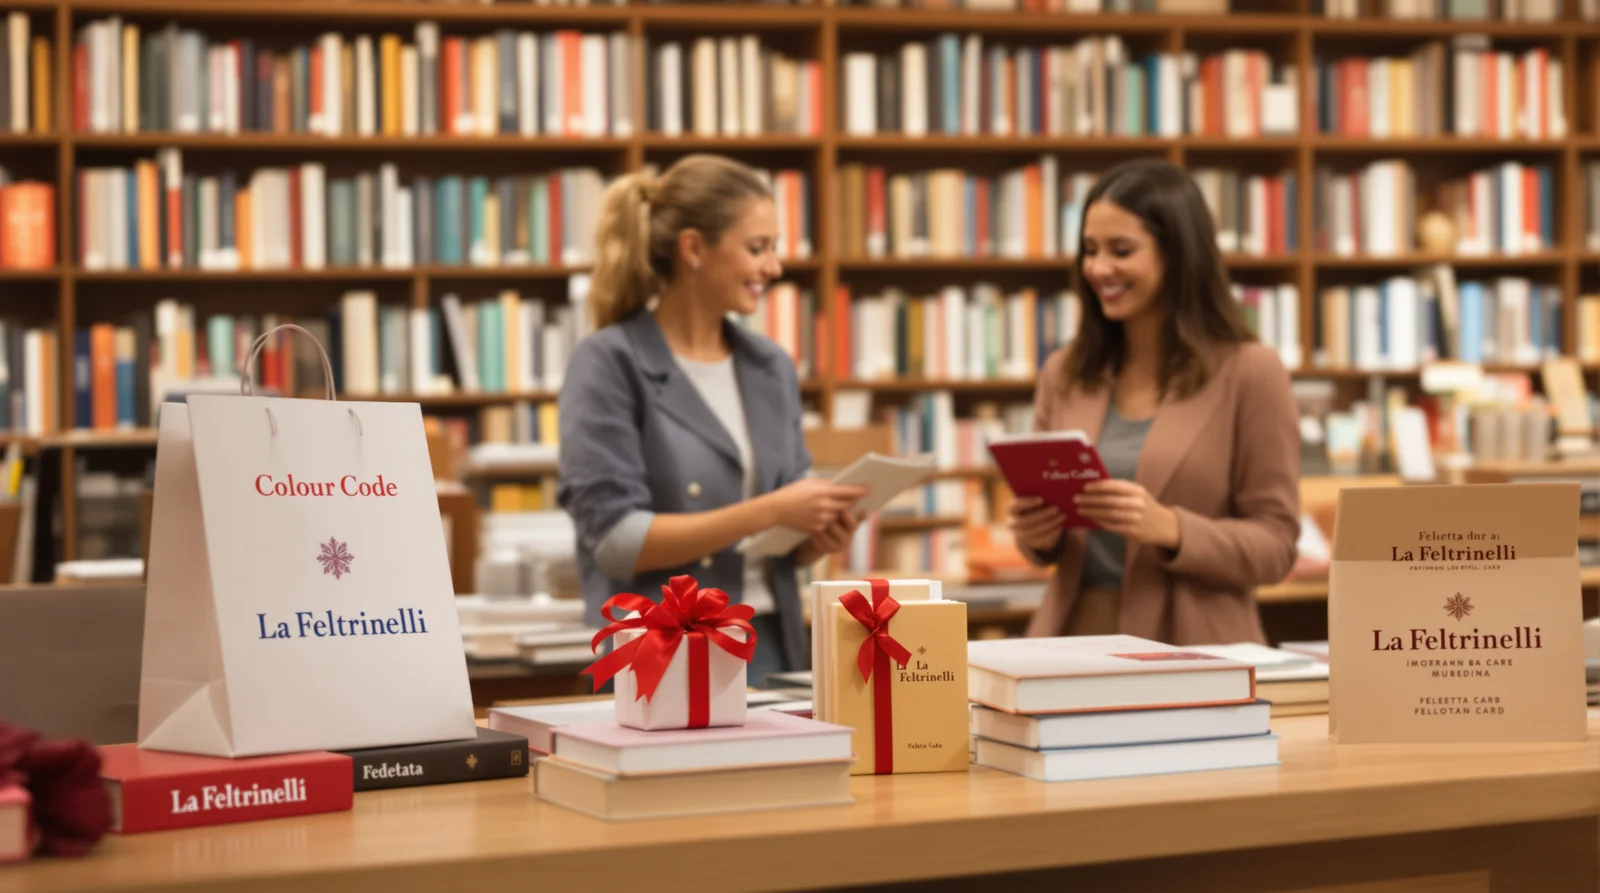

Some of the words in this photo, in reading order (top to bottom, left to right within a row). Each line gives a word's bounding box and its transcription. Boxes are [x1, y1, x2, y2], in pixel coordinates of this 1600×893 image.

[255, 474, 335, 497] Colour
[340, 474, 398, 497] Code
[1391, 546, 1414, 561] La
[1419, 544, 1516, 561] Feltrinelli
[256, 613, 291, 639] La
[295, 608, 428, 638] Feltrinelli
[1372, 630, 1404, 651] La
[1409, 626, 1543, 650] Feltrinelli
[916, 660, 928, 670] La
[1486, 658, 1513, 666] CARE
[1431, 670, 1490, 678] MUREDINA
[1414, 707, 1470, 715] FELLOTAN
[1475, 706, 1505, 715] CARD
[362, 762, 424, 780] Fedetata
[171, 789, 199, 814] La
[202, 777, 307, 810] Feltrinelli
